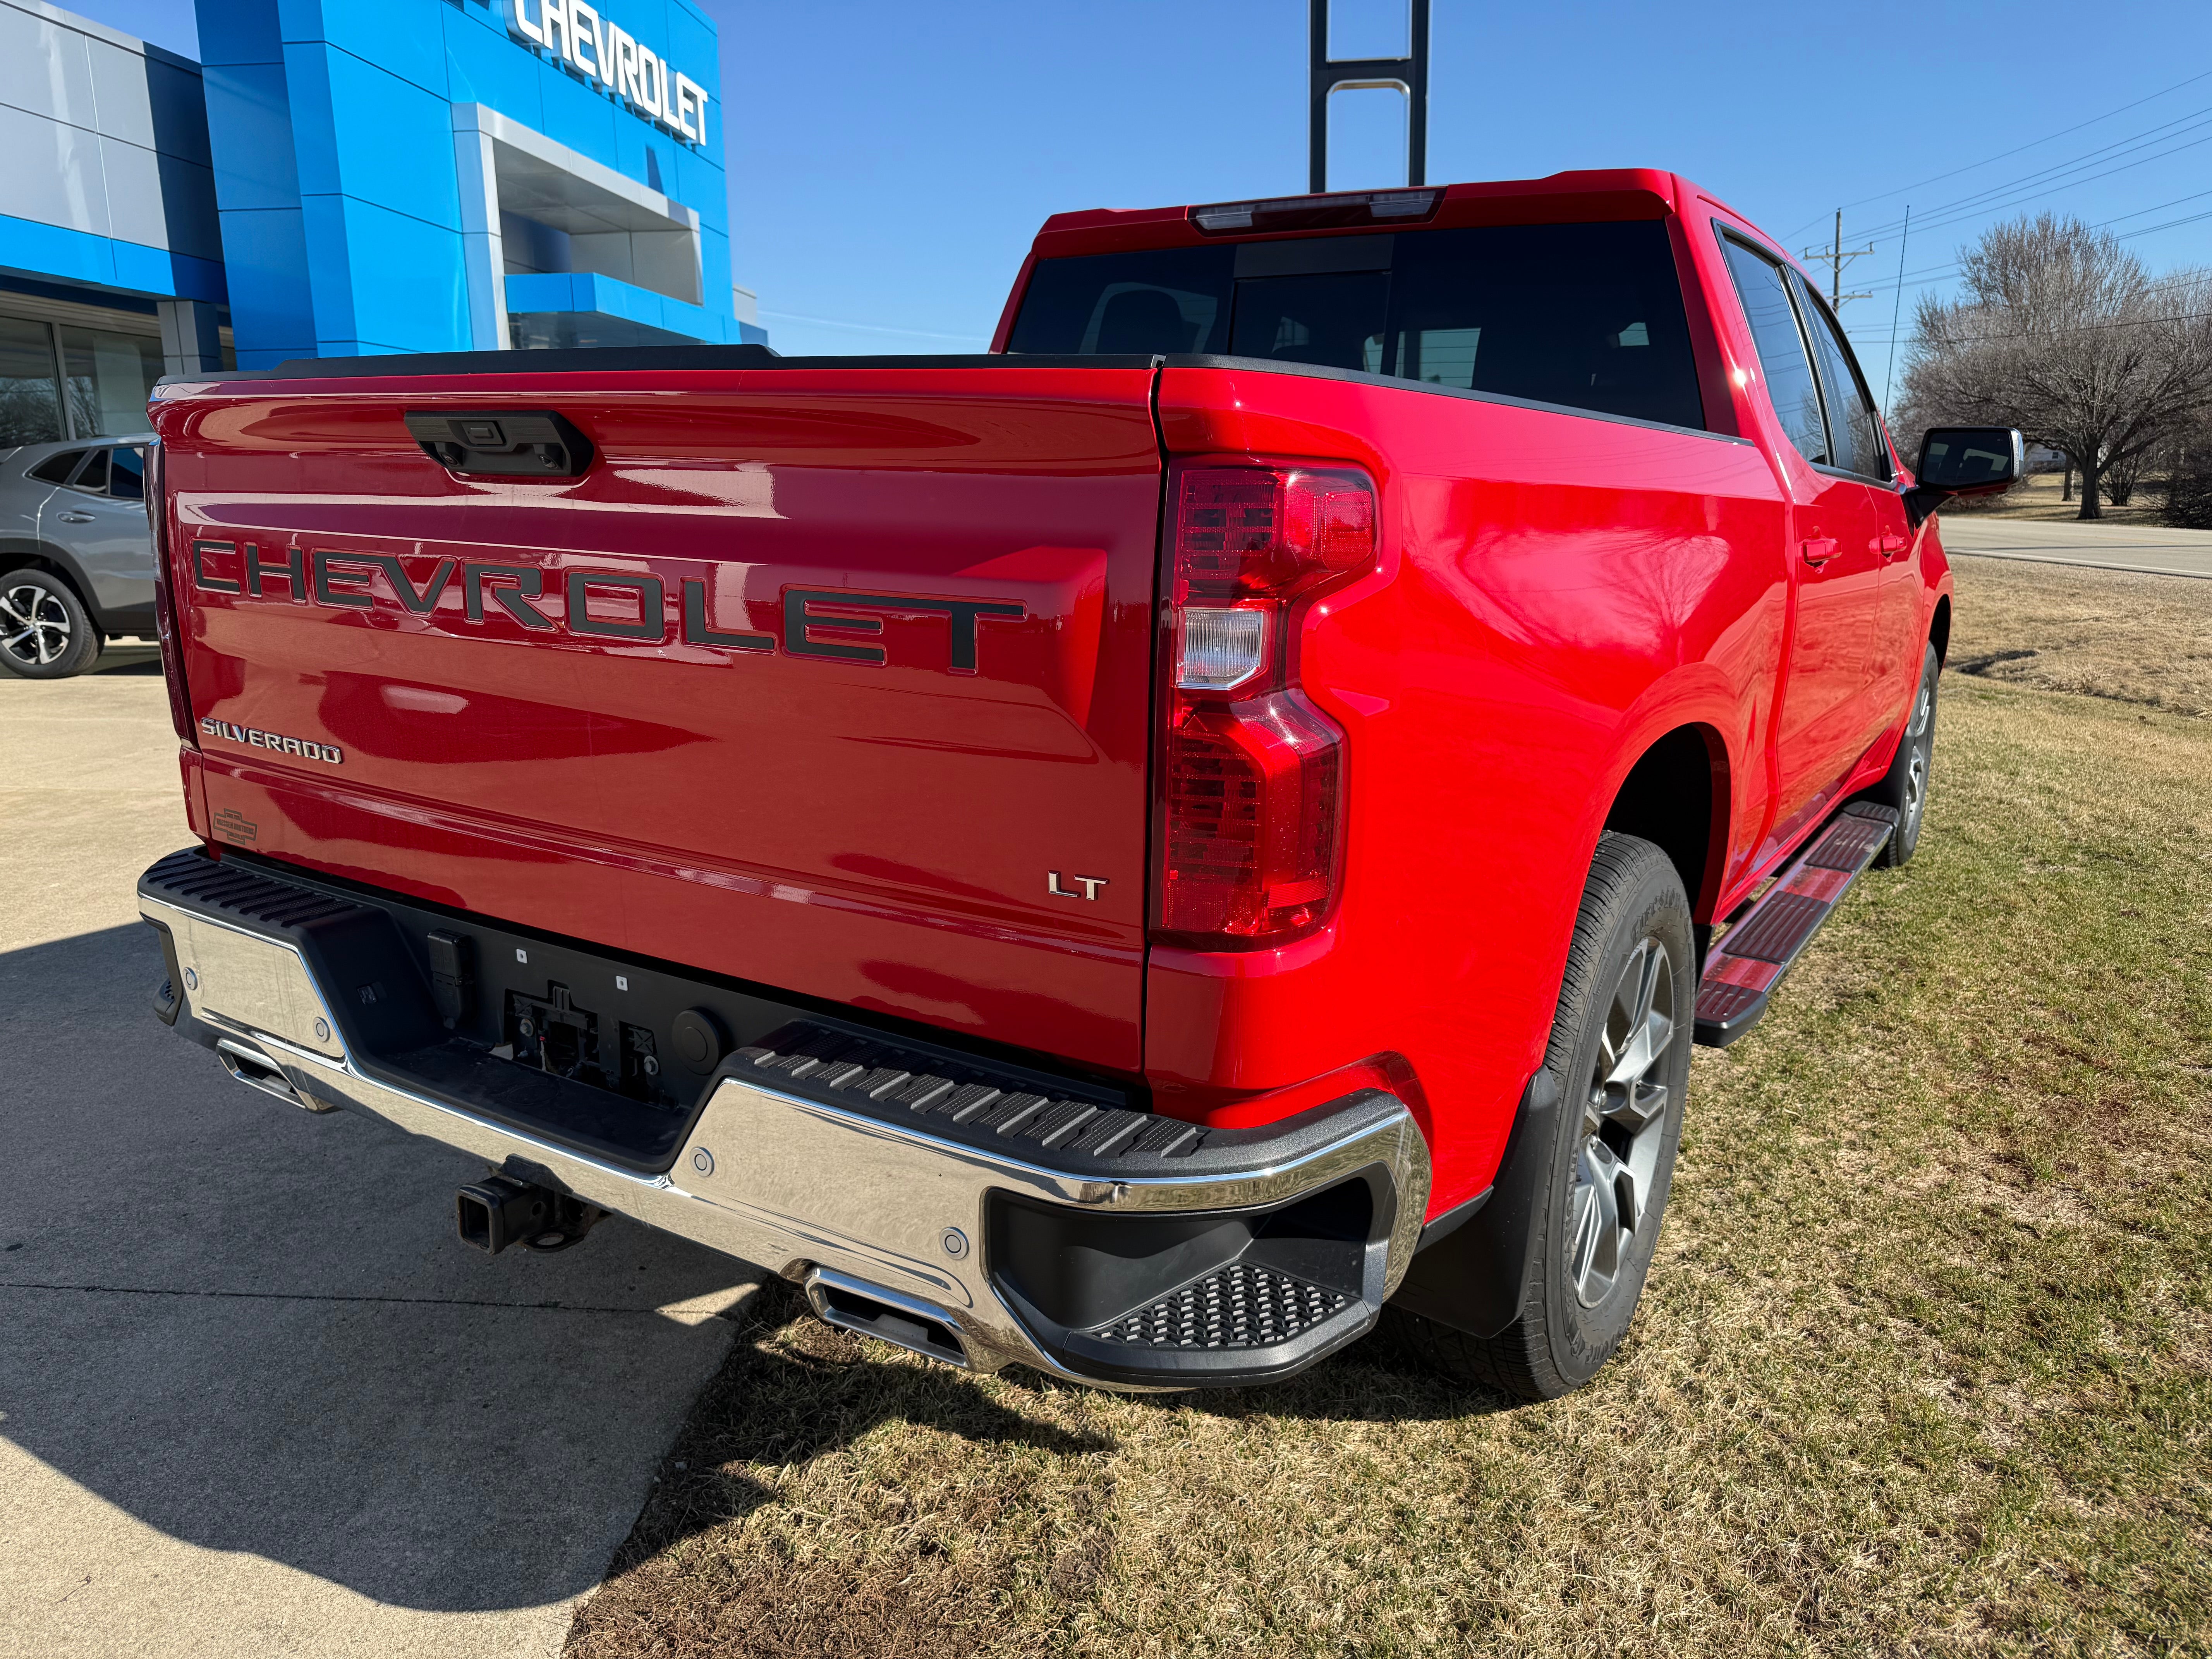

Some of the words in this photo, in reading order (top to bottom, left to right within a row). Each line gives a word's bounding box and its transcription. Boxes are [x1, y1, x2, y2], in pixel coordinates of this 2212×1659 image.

[192, 539, 1028, 675] CHEVROLET
[200, 717, 344, 764] SILVERADO
[1047, 870, 1110, 901] LT
